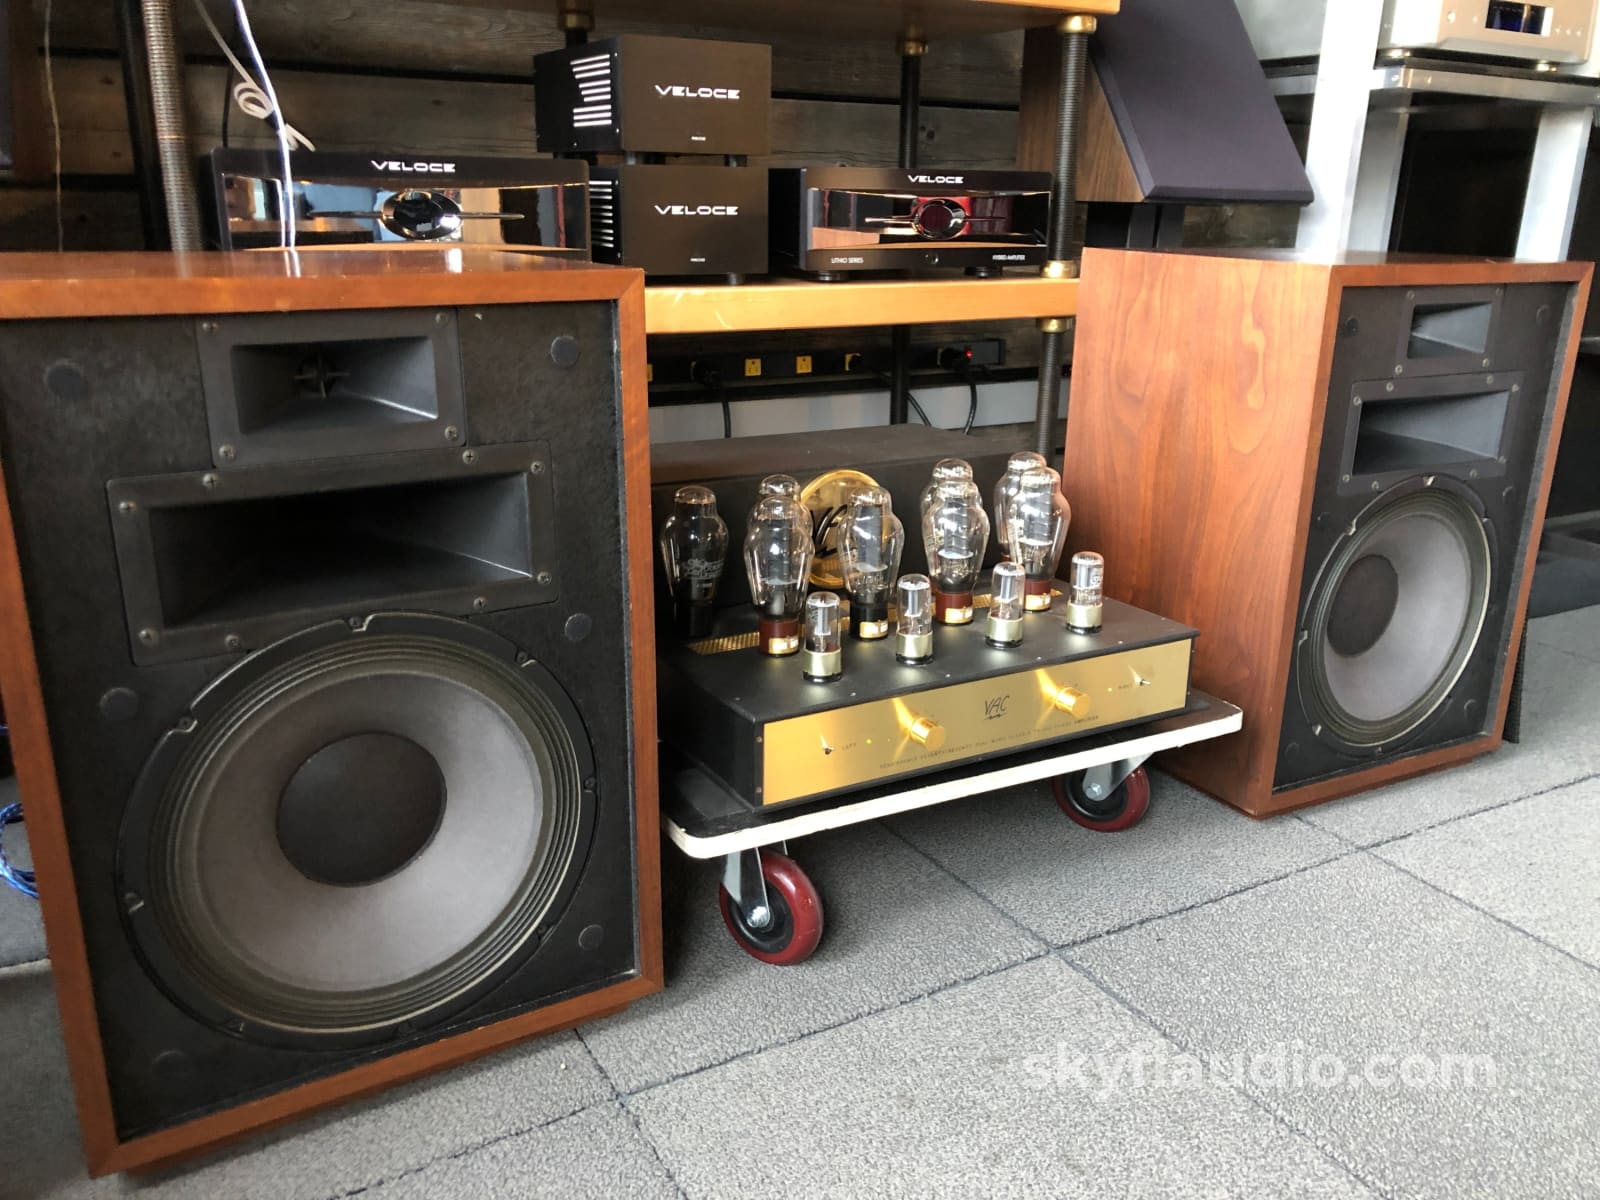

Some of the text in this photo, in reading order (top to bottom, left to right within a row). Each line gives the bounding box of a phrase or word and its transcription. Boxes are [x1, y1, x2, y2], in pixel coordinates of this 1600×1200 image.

[654, 84, 741, 101] VELOCE
[371, 159, 456, 173] VELOCE
[907, 174, 965, 185] VELOCE
[654, 204, 739, 217] VELOCE
[984, 695, 1010, 718] VAC
